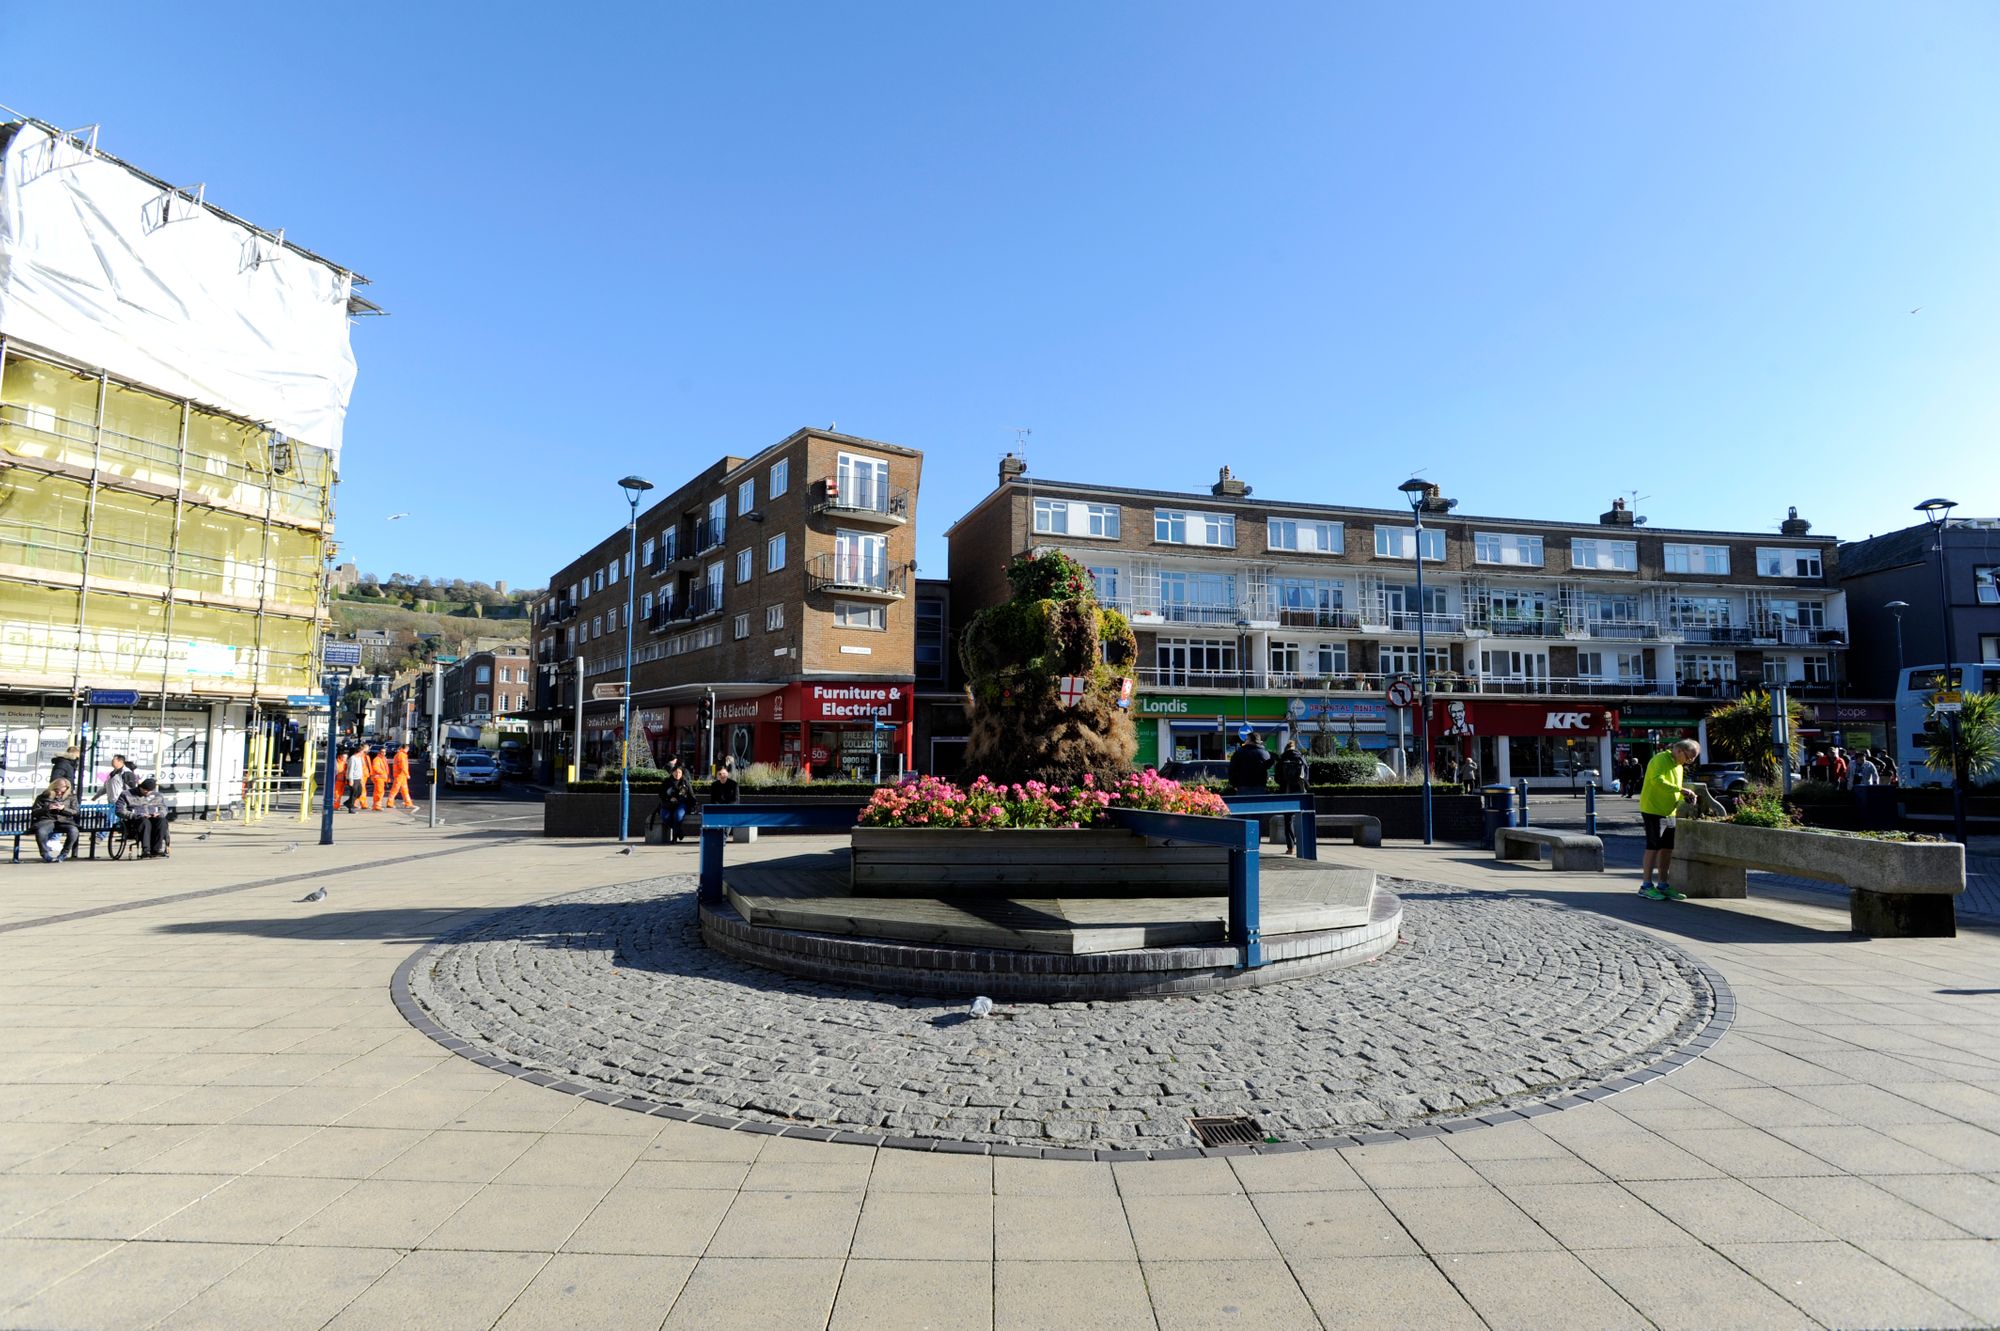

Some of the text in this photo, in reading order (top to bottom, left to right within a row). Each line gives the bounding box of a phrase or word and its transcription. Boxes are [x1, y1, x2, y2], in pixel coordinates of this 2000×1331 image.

[814, 686, 901, 700] Furniture &
[723, 705, 728, 718] &
[728, 701, 759, 718] Electrical
[822, 702, 892, 716] Electrical
[1143, 698, 1188, 712] Londis
[1622, 706, 1632, 715] 15
[1544, 712, 1591, 729] KFC
[869, 731, 888, 740] FST
[843, 740, 889, 748] COLLECTON
